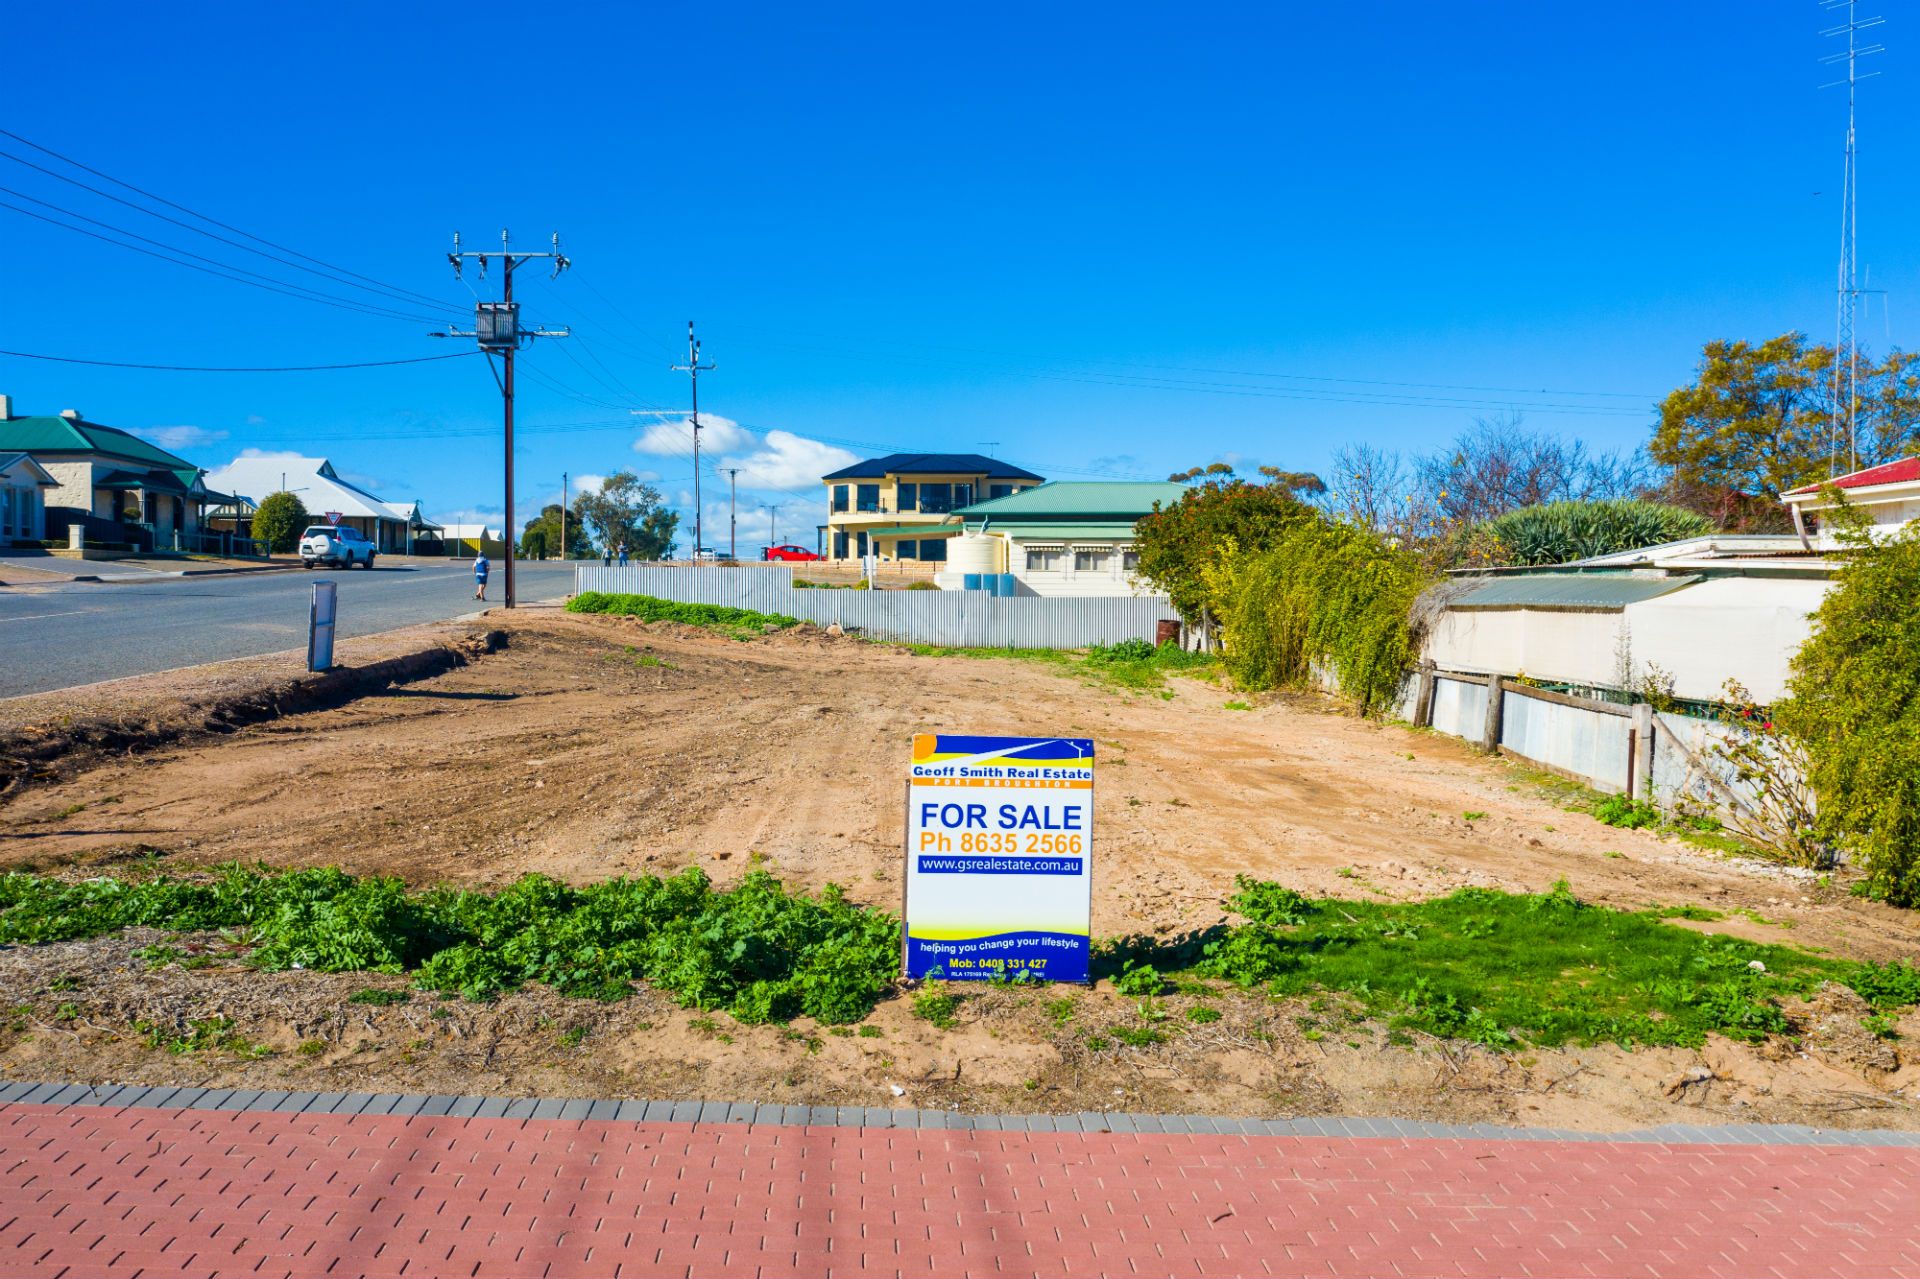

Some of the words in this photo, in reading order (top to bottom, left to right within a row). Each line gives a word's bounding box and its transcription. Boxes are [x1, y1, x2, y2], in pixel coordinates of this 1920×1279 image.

[913, 766, 955, 776] Geoff
[960, 767, 1003, 777] Smith
[1007, 768, 1039, 778] Real
[1043, 768, 1091, 779] Estate
[984, 779, 1071, 788] BROUGHTON
[921, 803, 988, 829] FOR
[998, 804, 1082, 830] SALE
[920, 832, 951, 852] Ph
[960, 832, 1018, 853] 8635
[1025, 833, 1082, 854] 2566
[922, 858, 1079, 872] www.gsrealestate.com.au
[920, 942, 956, 955] helping
[959, 944, 977, 954] you
[979, 940, 1015, 951] change
[1017, 938, 1040, 948] your
[1041, 937, 1079, 949] lifestyle
[949, 958, 976, 968] Mob:
[1007, 959, 1025, 968] 331
[1028, 959, 1048, 969] 427
